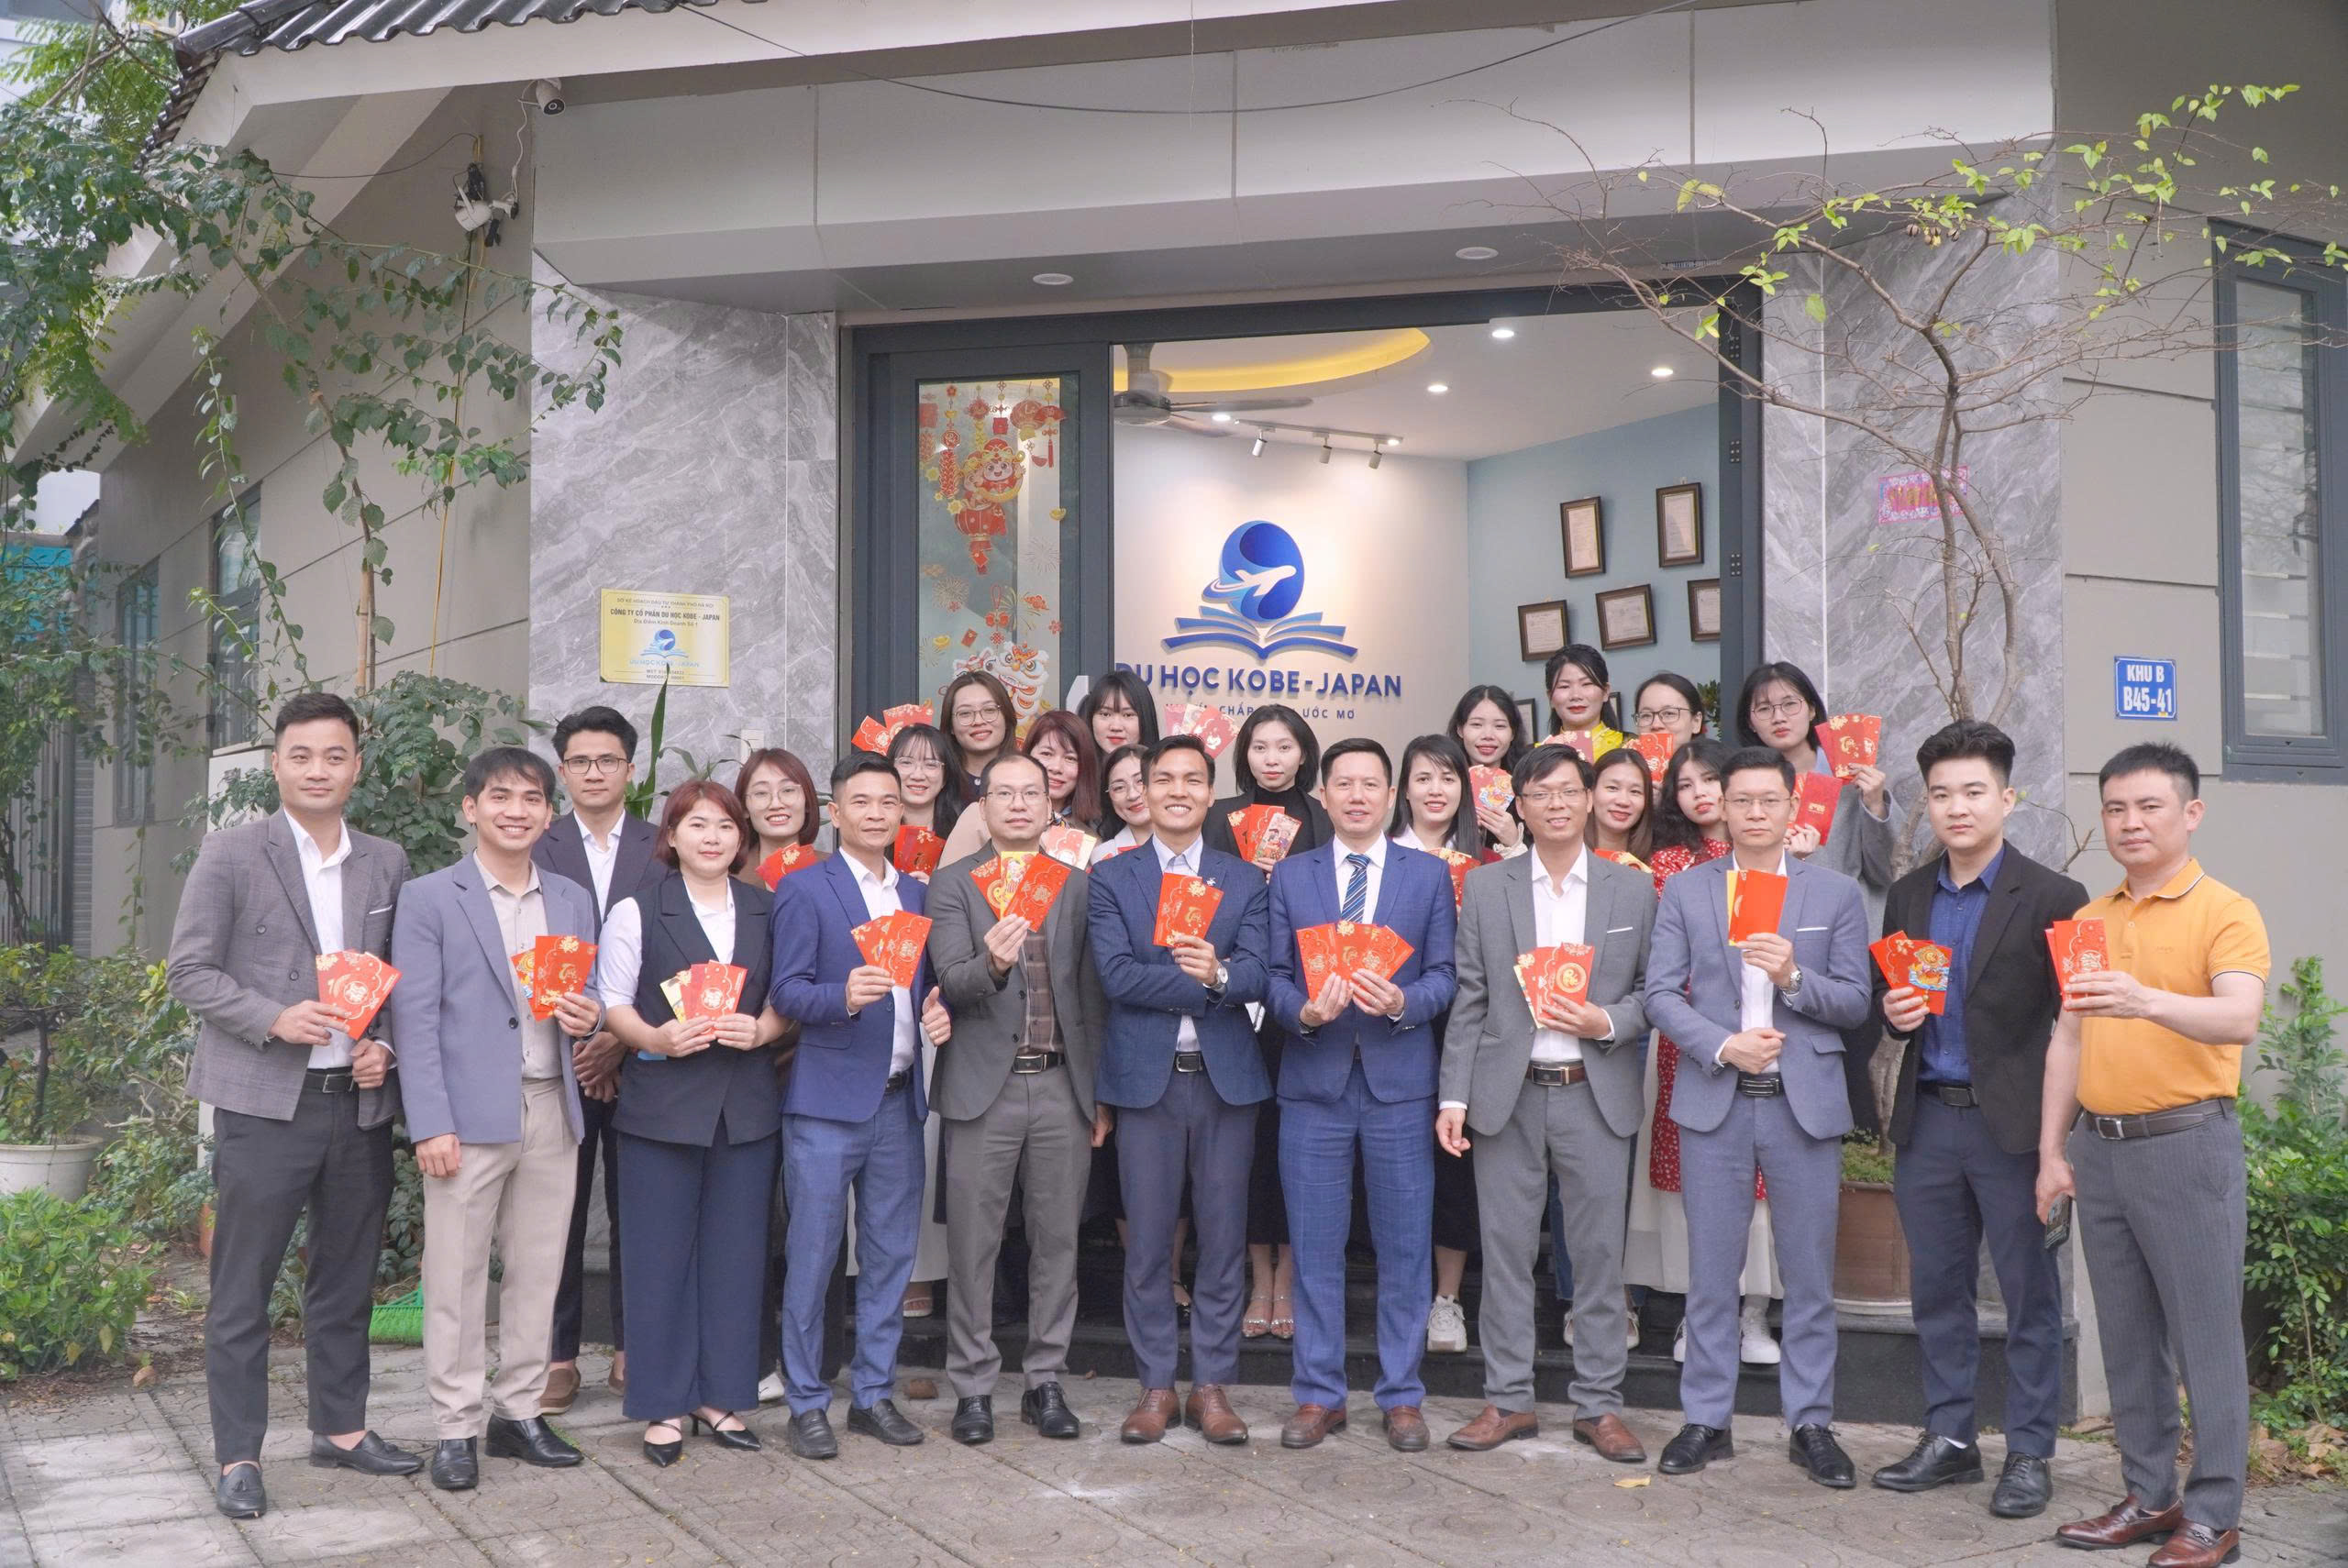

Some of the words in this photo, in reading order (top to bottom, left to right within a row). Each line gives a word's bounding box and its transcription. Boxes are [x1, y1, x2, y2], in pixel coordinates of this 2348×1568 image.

[1160, 665, 1220, 696] HỌC
[2126, 664, 2153, 682] KHU
[2155, 666, 2165, 683] B
[2123, 686, 2172, 712] B45-41
